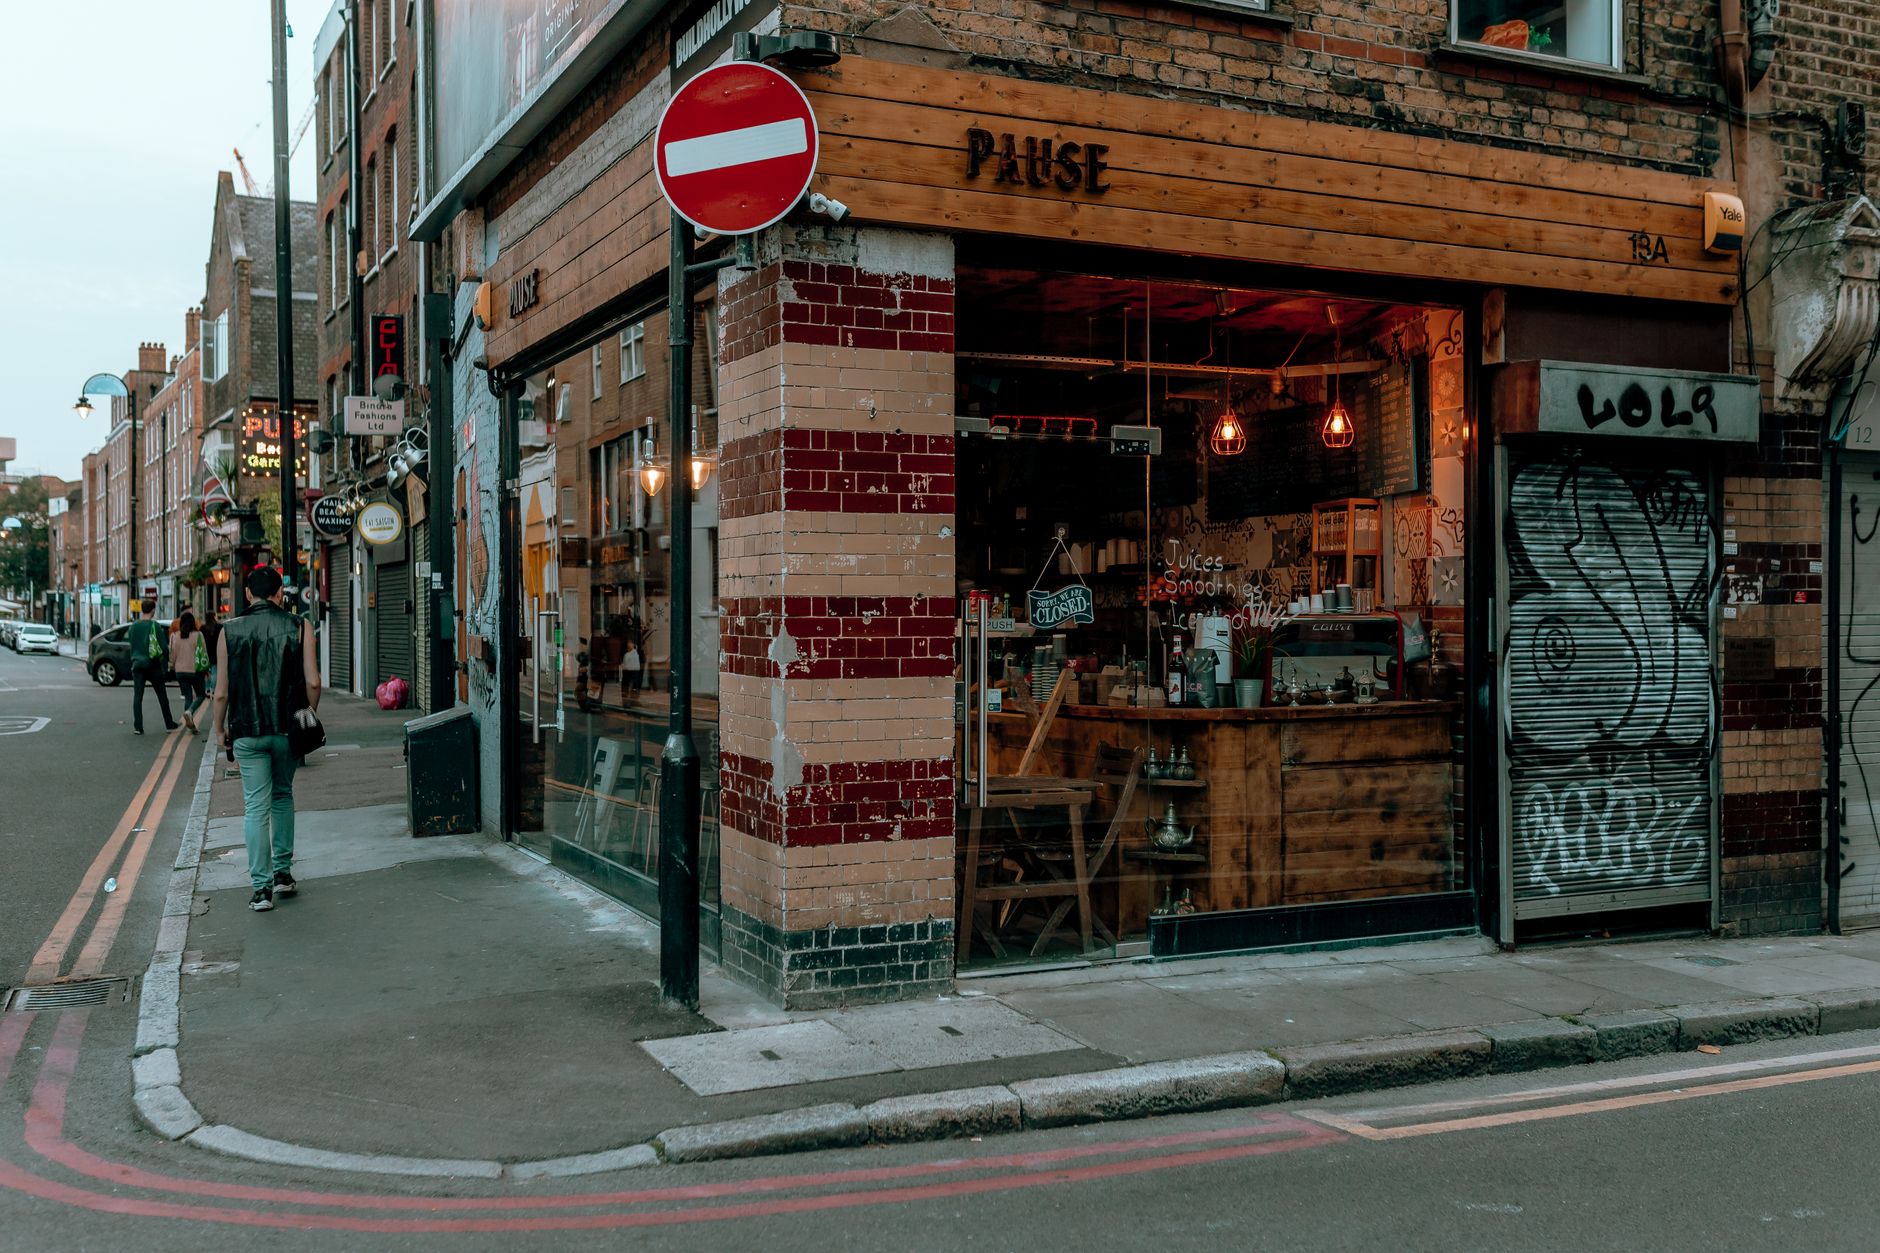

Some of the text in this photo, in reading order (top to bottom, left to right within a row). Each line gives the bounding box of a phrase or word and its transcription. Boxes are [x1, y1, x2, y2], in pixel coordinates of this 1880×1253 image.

[967, 128, 1110, 193] PAUSE
[1720, 206, 1742, 222] Yale
[1628, 232, 1669, 263] 13A
[510, 268, 539, 318] PAUSE
[354, 411, 396, 420] Fashions
[368, 422, 384, 430] Ltd
[1856, 426, 1872, 443] 12
[317, 517, 352, 525] WAXING
[1165, 539, 1224, 572] Juices
[1059, 591, 1070, 601] WE
[1071, 588, 1083, 597] ARE
[1163, 569, 1263, 600] Smoothies
[1036, 596, 1087, 623] CLOSED
